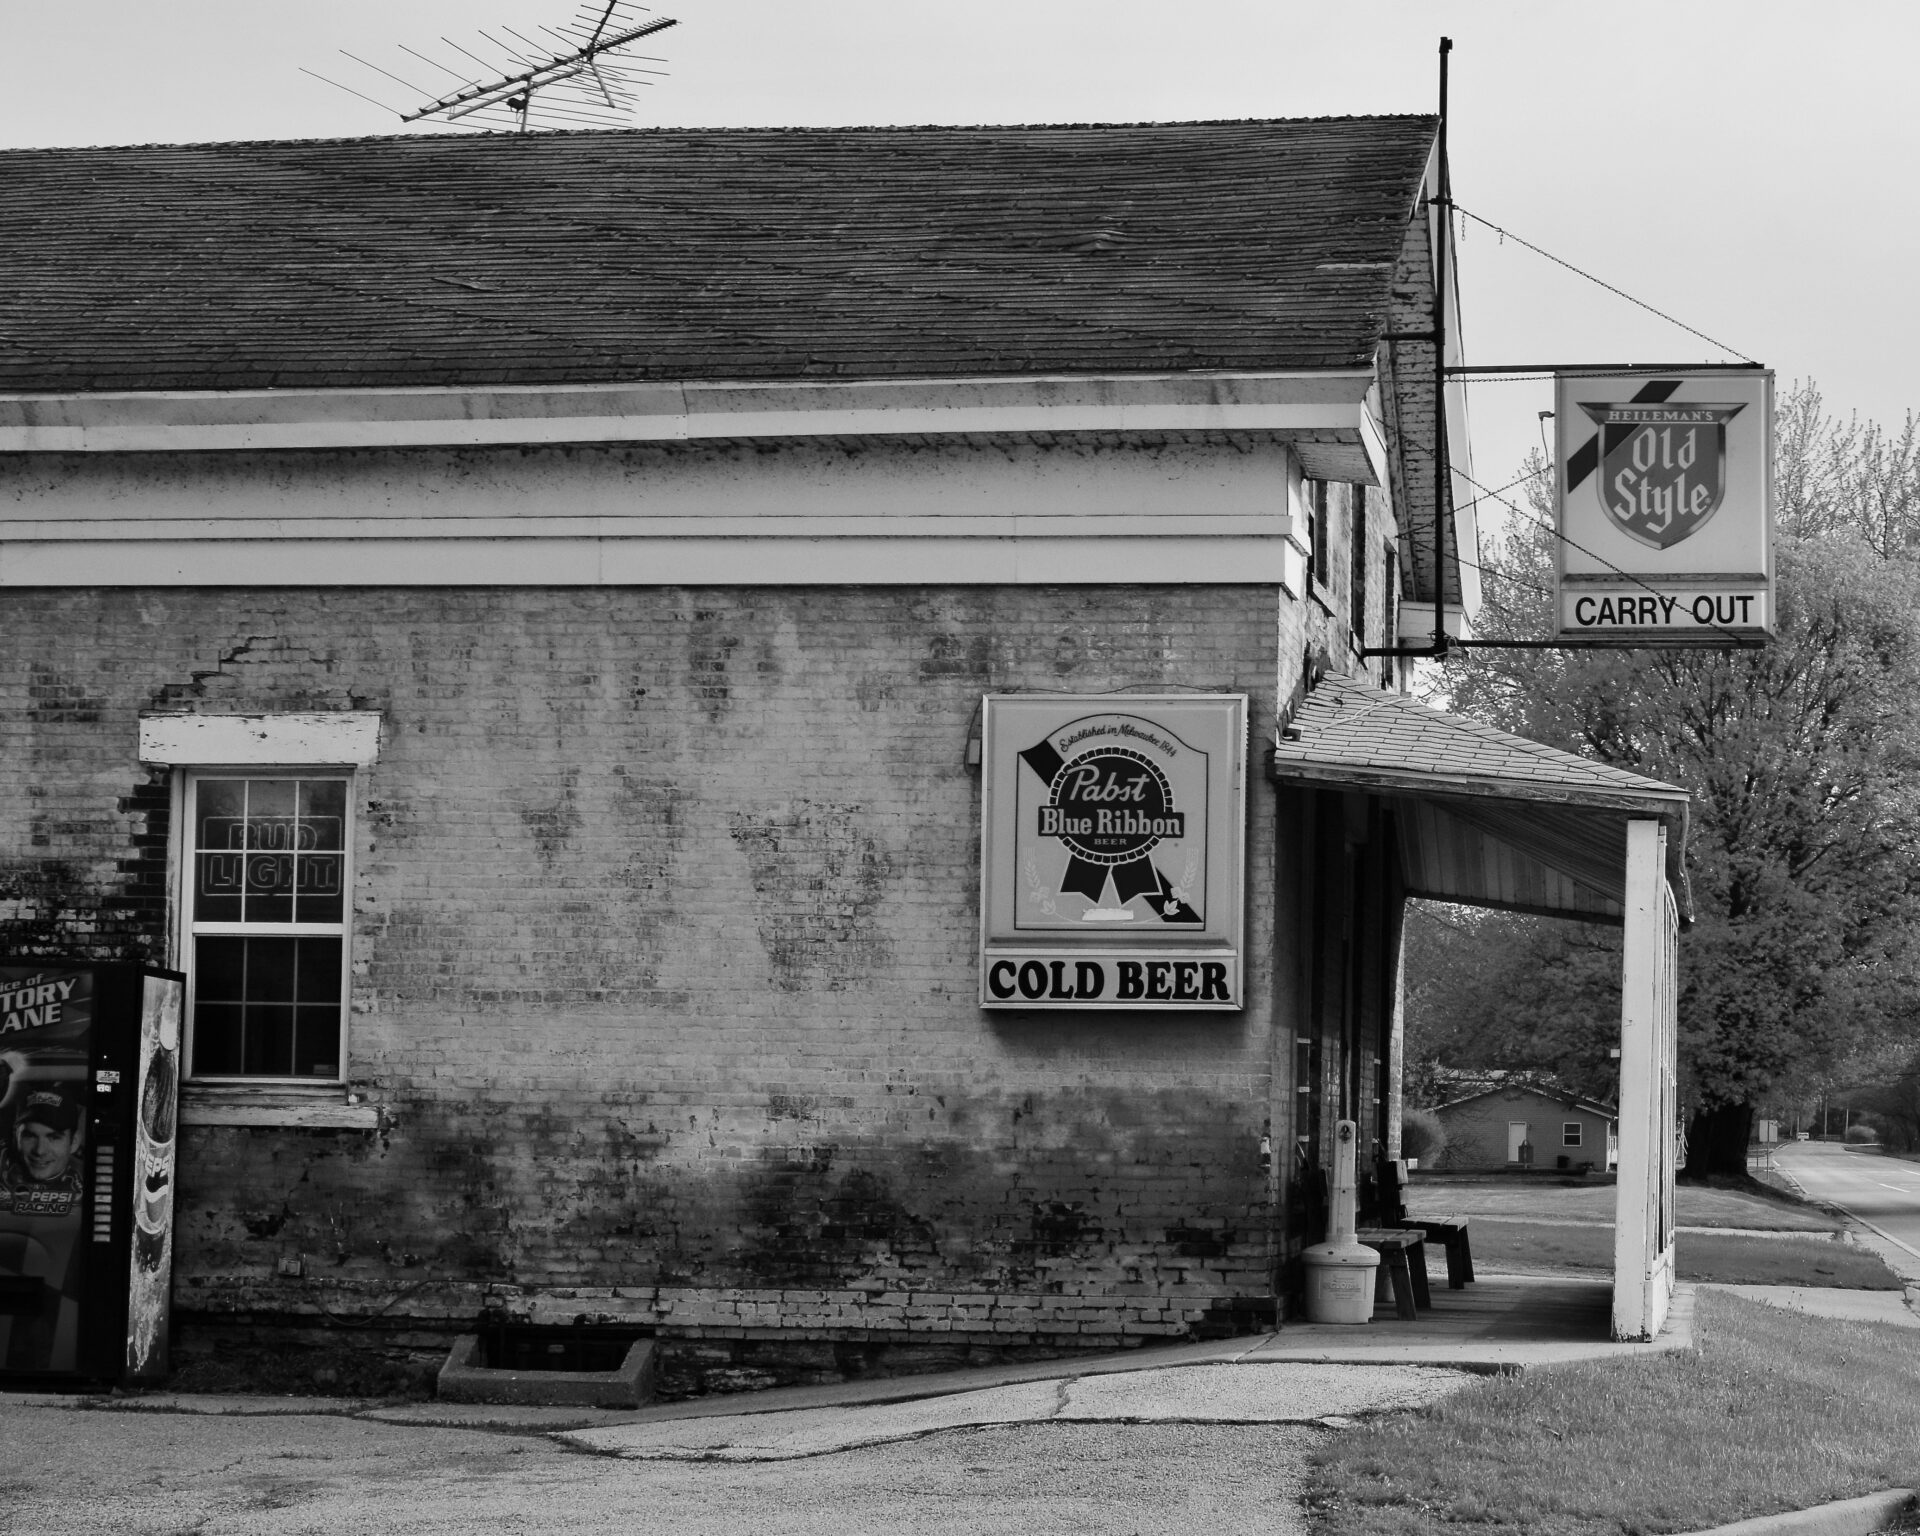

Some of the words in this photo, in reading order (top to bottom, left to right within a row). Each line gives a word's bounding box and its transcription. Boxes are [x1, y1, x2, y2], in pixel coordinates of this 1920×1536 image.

[1608, 410, 1714, 422] HEILEMAN'S
[1632, 426, 1697, 472] Old
[1613, 467, 1710, 534] Style
[1575, 596, 1677, 626] CARRY
[1692, 595, 1755, 625] OUT
[1059, 724, 1106, 752] Established
[1107, 725, 1117, 736] in
[1117, 724, 1159, 747] Milwaukee
[1159, 740, 1178, 758] 1844
[1066, 764, 1151, 802] Pabst
[1041, 808, 1093, 835] Blue
[1096, 808, 1182, 836] Ribbon
[228, 823, 318, 853] BUD
[1093, 838, 1128, 846] BEER
[209, 855, 336, 888] LIGHT
[26, 973, 45, 987] of
[988, 960, 1105, 999] COLD
[1115, 961, 1231, 1000] BEER
[15, 1202, 68, 1213] RACING
[30, 1191, 73, 1203] PEPSI
